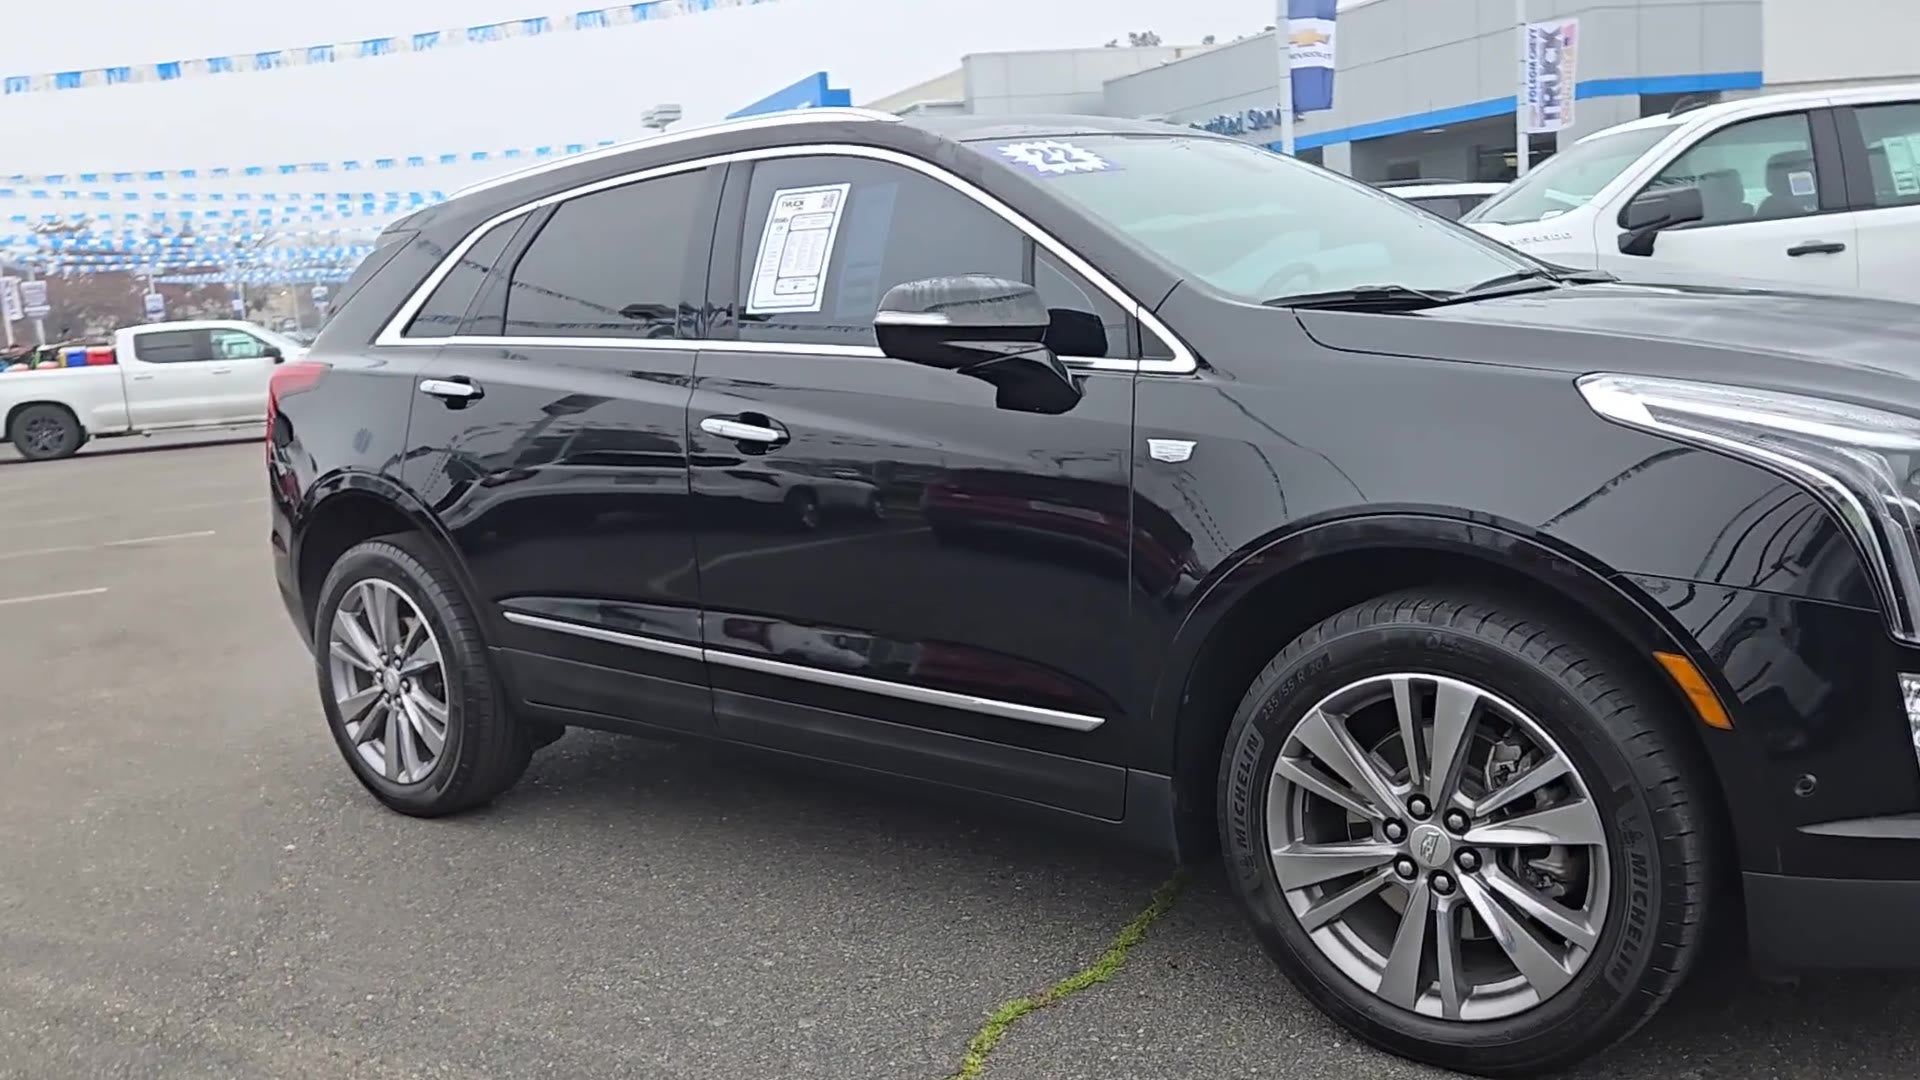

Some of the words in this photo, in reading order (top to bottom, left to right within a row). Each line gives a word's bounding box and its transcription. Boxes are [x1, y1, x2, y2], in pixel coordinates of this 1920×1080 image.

[1539, 26, 1563, 127] TRUCK
[1025, 147, 1088, 165] 22
[1233, 733, 1259, 848] MICHELIN
[1611, 852, 1649, 982] MICHELIN
